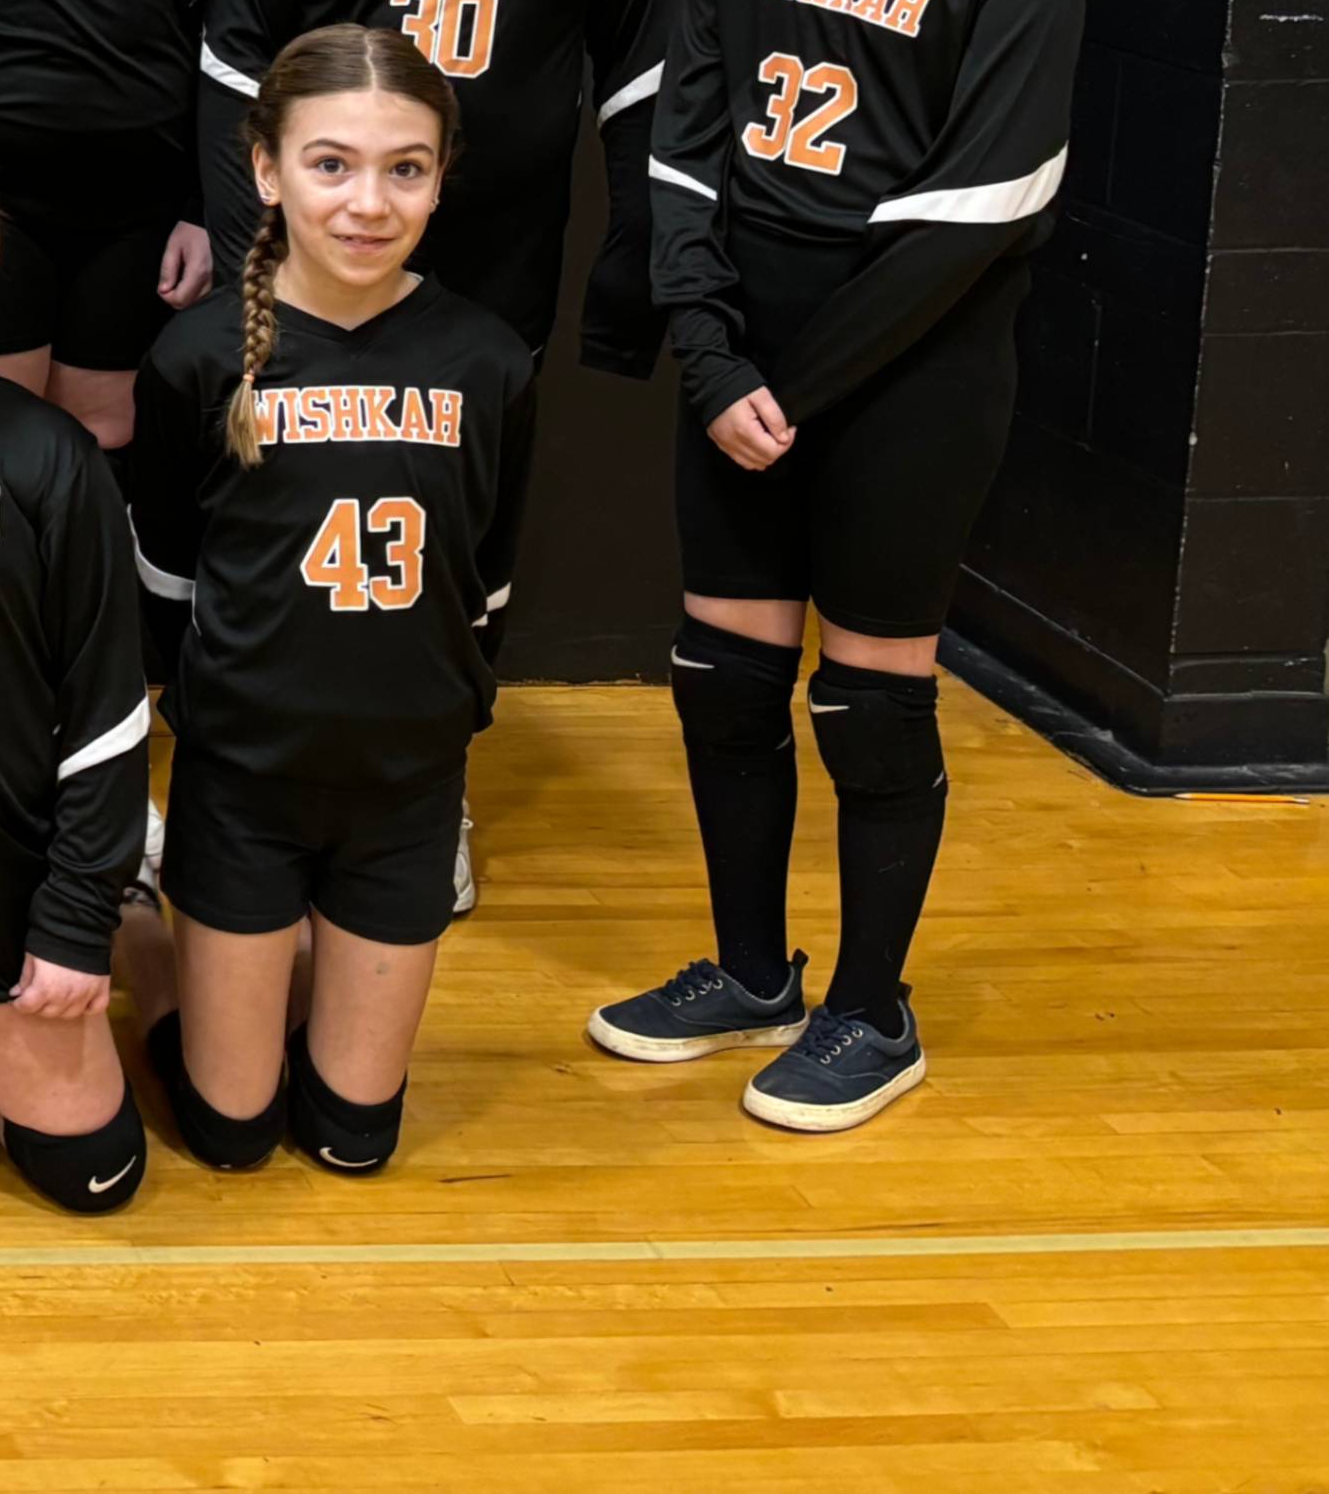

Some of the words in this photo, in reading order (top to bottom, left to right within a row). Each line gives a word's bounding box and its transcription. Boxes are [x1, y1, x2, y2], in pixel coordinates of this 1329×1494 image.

[741, 51, 859, 176] 32
[252, 385, 463, 448] WISHKAH
[300, 496, 427, 612] 43
